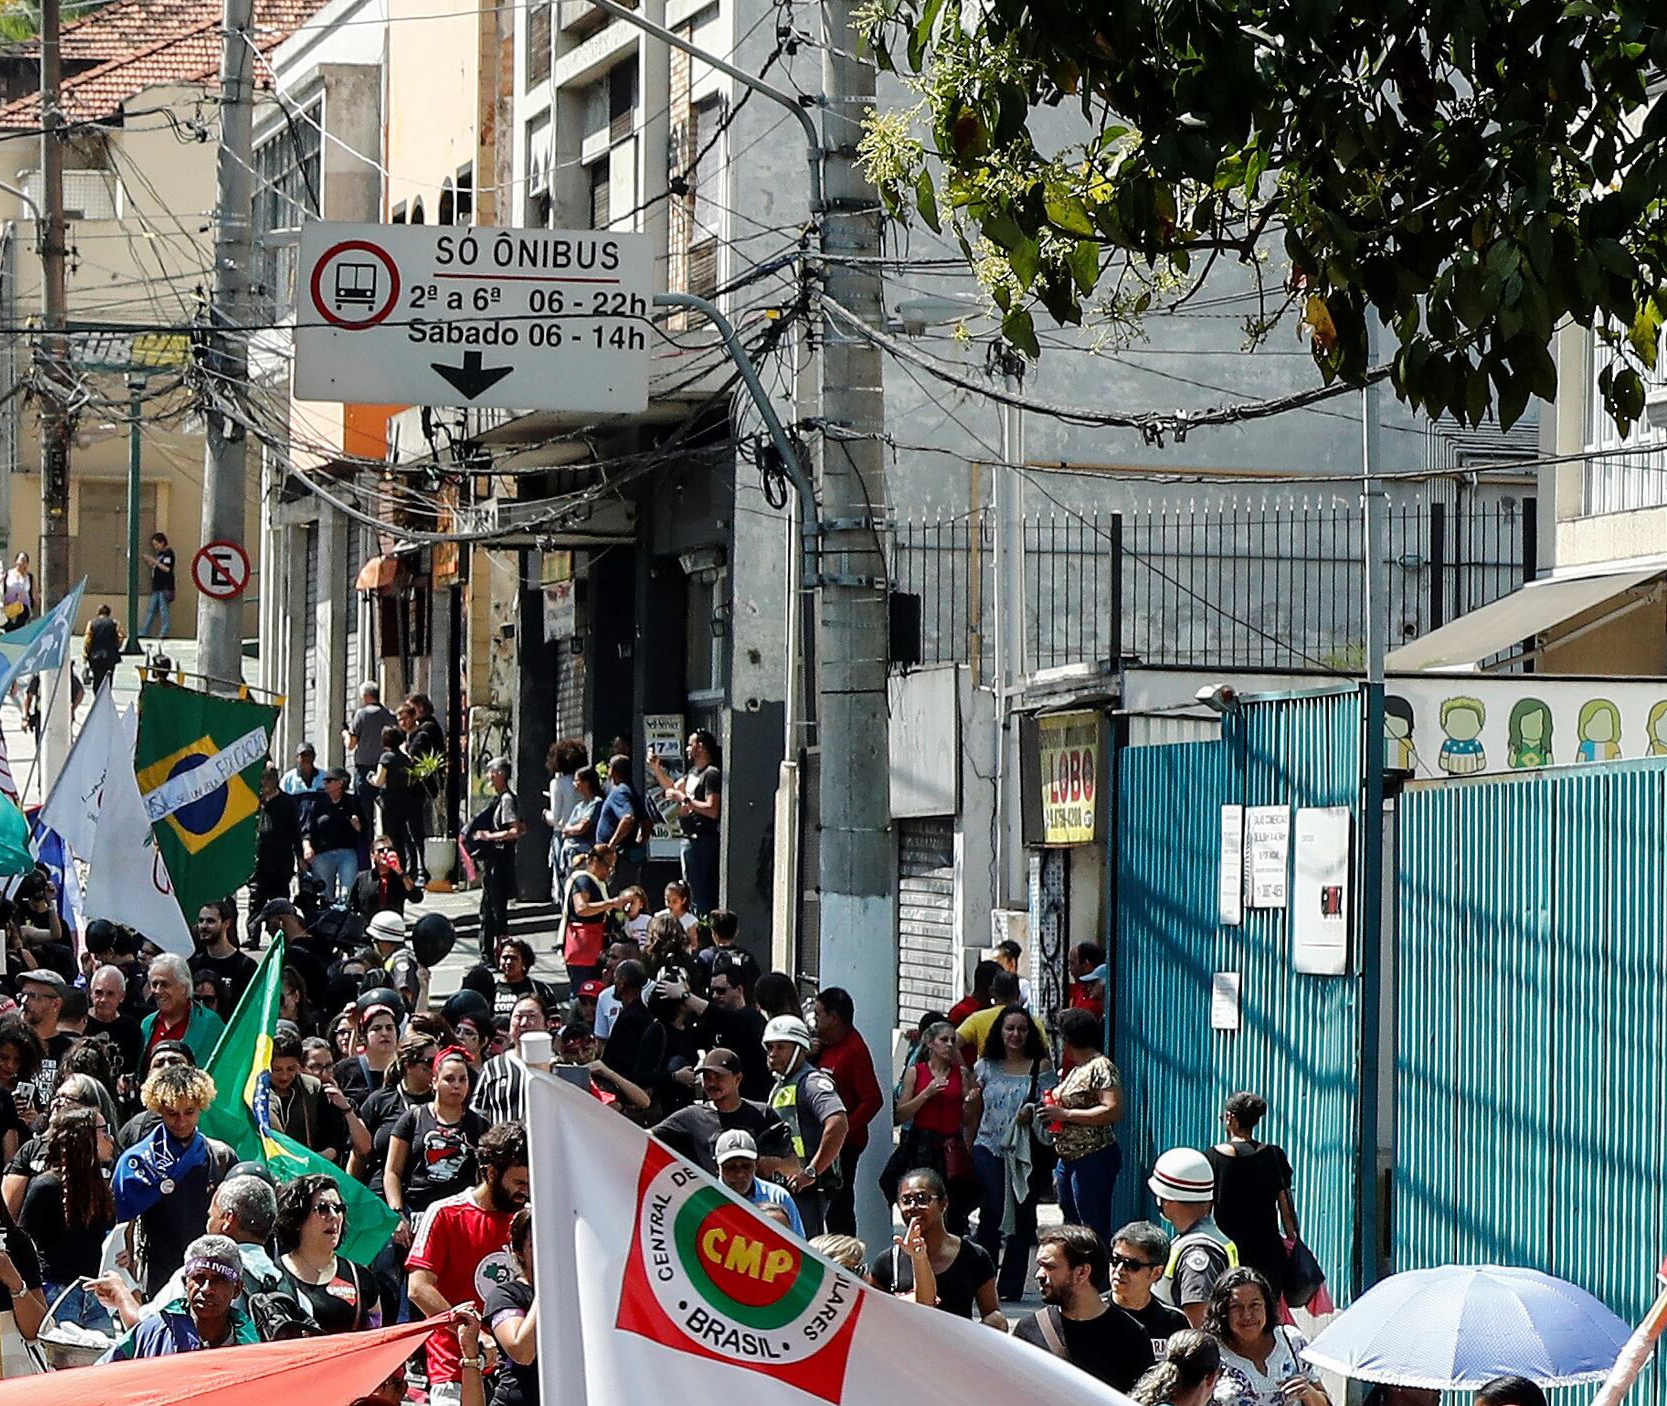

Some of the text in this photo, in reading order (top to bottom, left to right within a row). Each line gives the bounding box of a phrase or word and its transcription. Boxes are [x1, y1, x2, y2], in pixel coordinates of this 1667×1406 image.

[434, 228, 621, 271] SÓ ÔNIBUS
[409, 284, 438, 309] 2ª
[446, 291, 463, 310] a
[472, 287, 501, 311] 6ª
[528, 289, 564, 313] 06
[592, 291, 647, 316] 22h
[407, 318, 519, 346] Sábado
[528, 323, 563, 348] 06
[592, 325, 646, 350] 14h
[1049, 747, 1097, 804] LOBO
[650, 1191, 675, 1283] CENTRAL
[670, 1166, 699, 1188] DE
[701, 1226, 794, 1284] CMP
[684, 1306, 781, 1359] BRASIL
